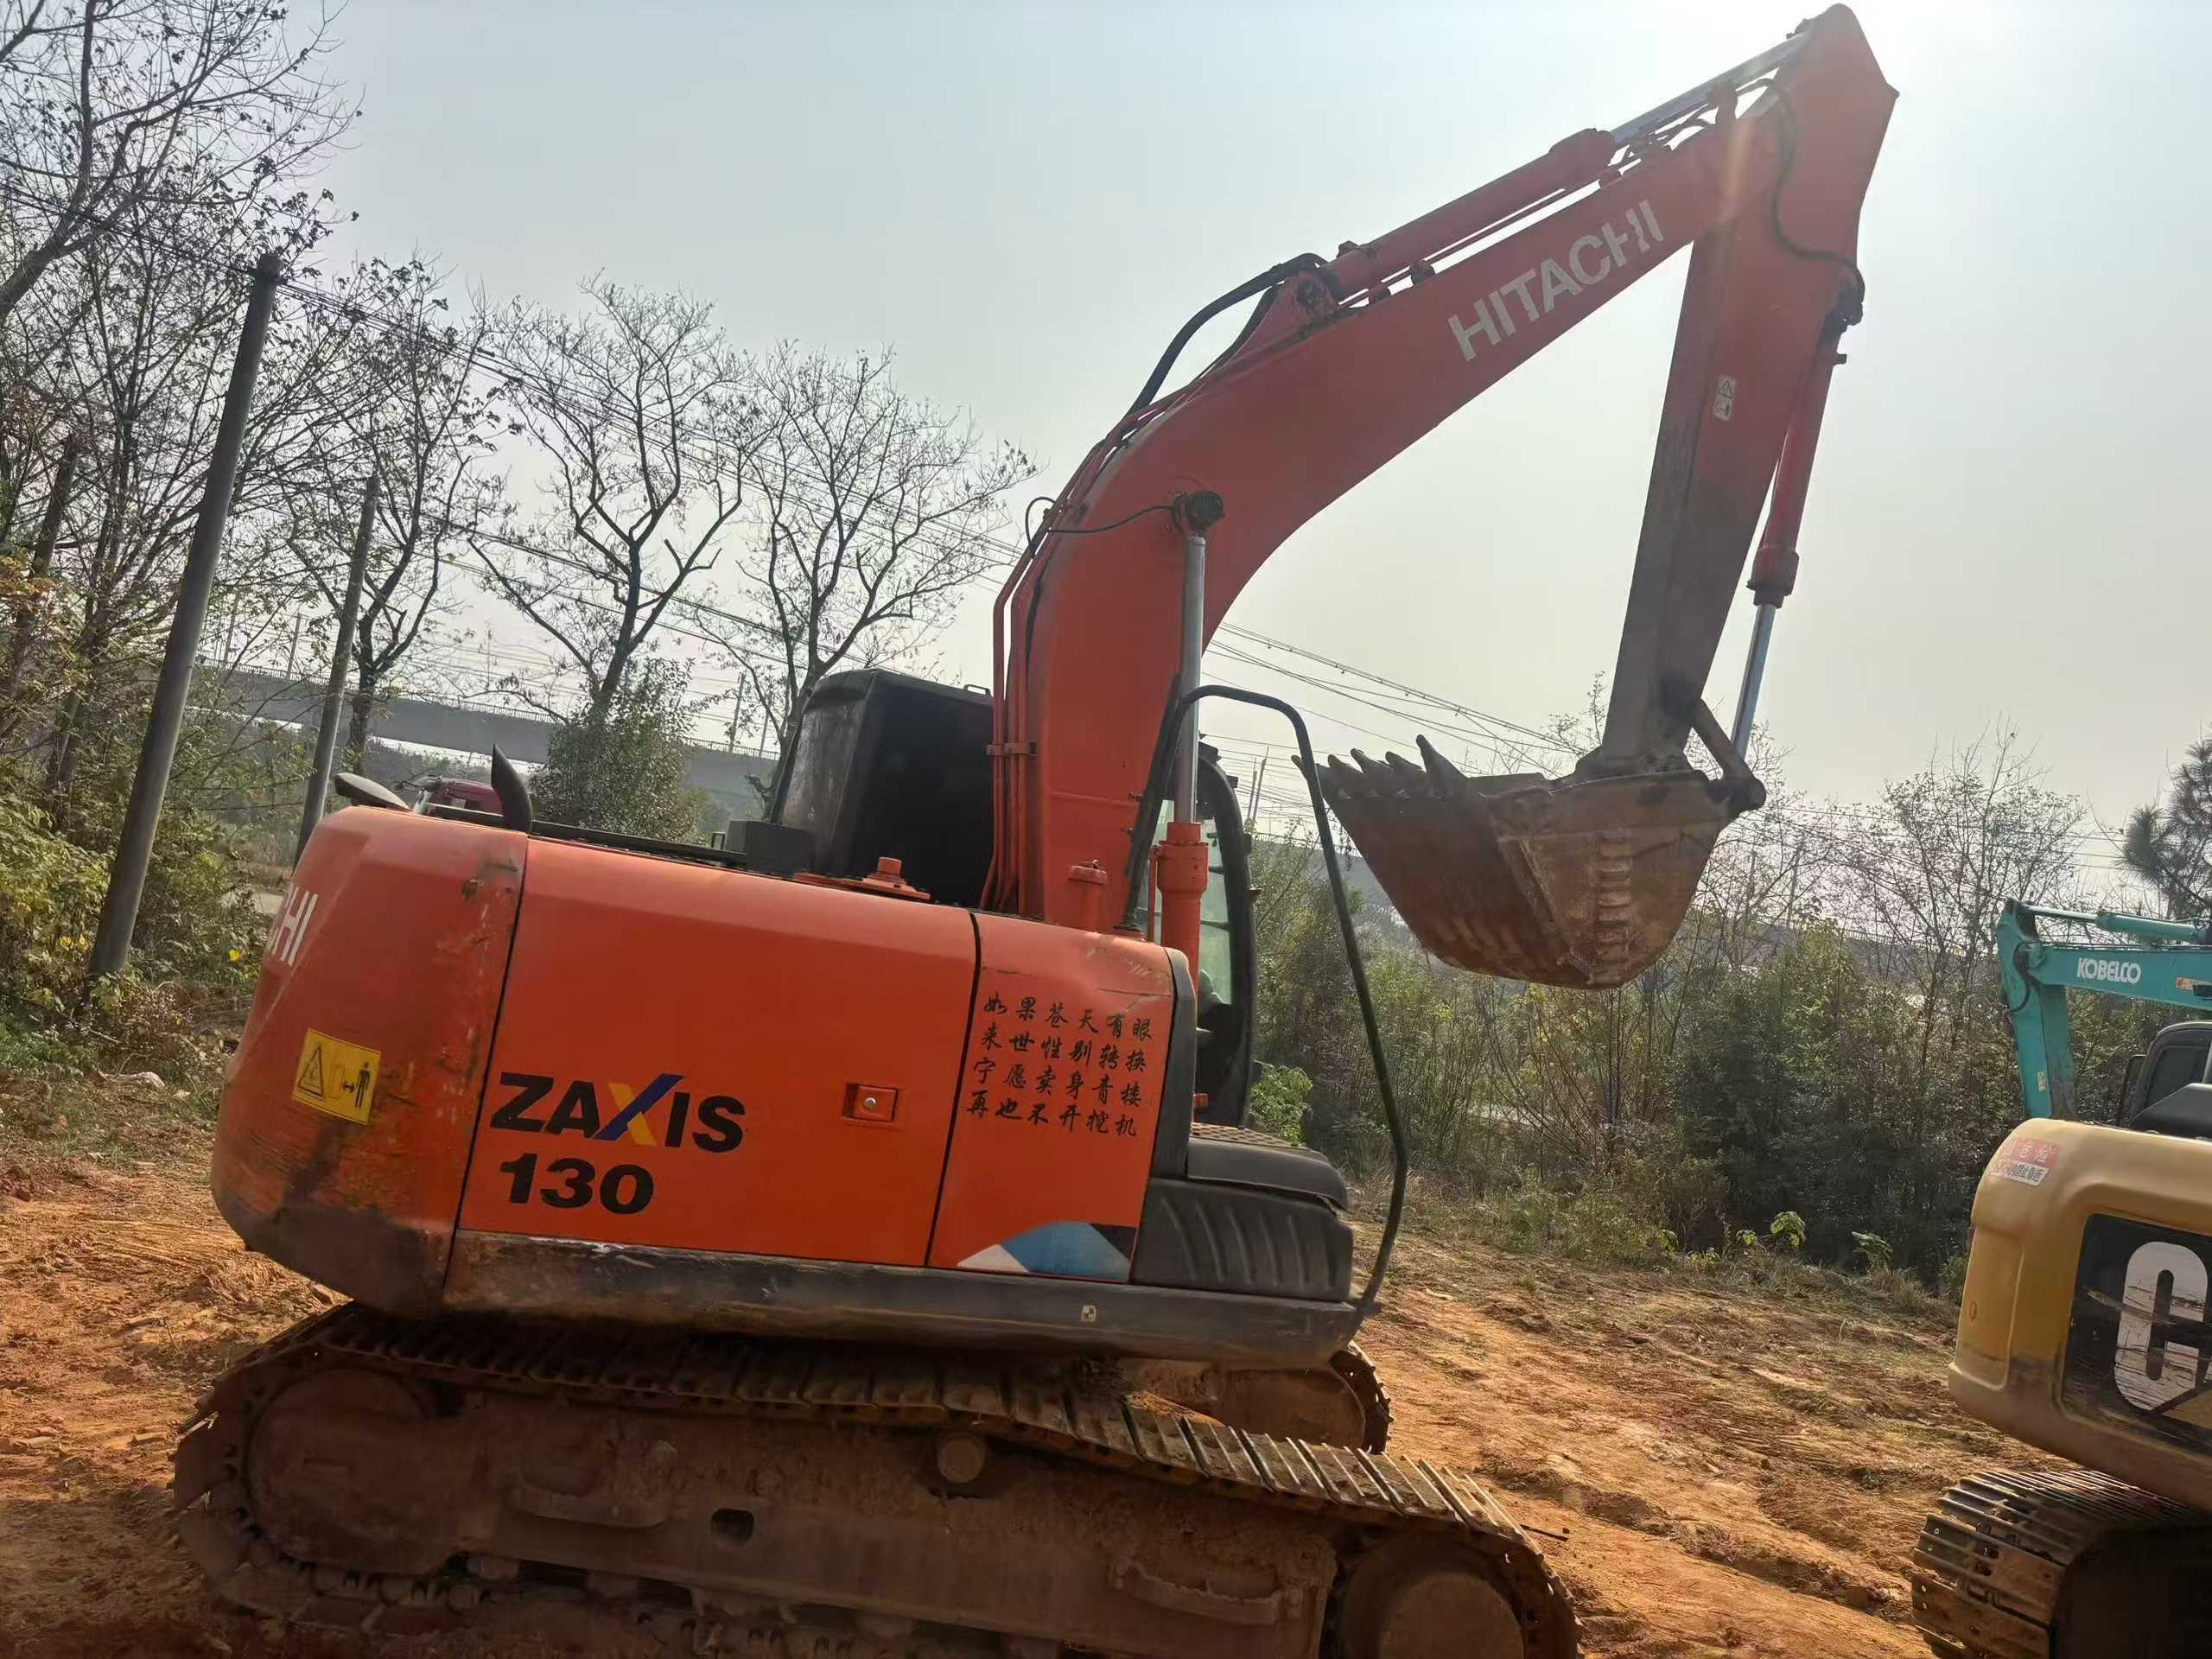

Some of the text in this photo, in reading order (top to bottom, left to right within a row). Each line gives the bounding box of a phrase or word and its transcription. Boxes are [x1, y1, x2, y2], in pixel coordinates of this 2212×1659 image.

[1447, 198, 1664, 361] HITACHI
[269, 882, 319, 967] HI
[2076, 957, 2141, 984] KOBELCO
[983, 991, 1153, 1041] 如果苍天有眼
[980, 1022, 1147, 1073] 来世性别转换
[973, 1057, 1142, 1107] 宁愿卖身青楼
[490, 1071, 746, 1153] ZAXIS
[966, 1089, 1137, 1137] 再也不开挖机
[499, 1153, 654, 1214] 130
[2114, 1242, 2212, 1410] C
